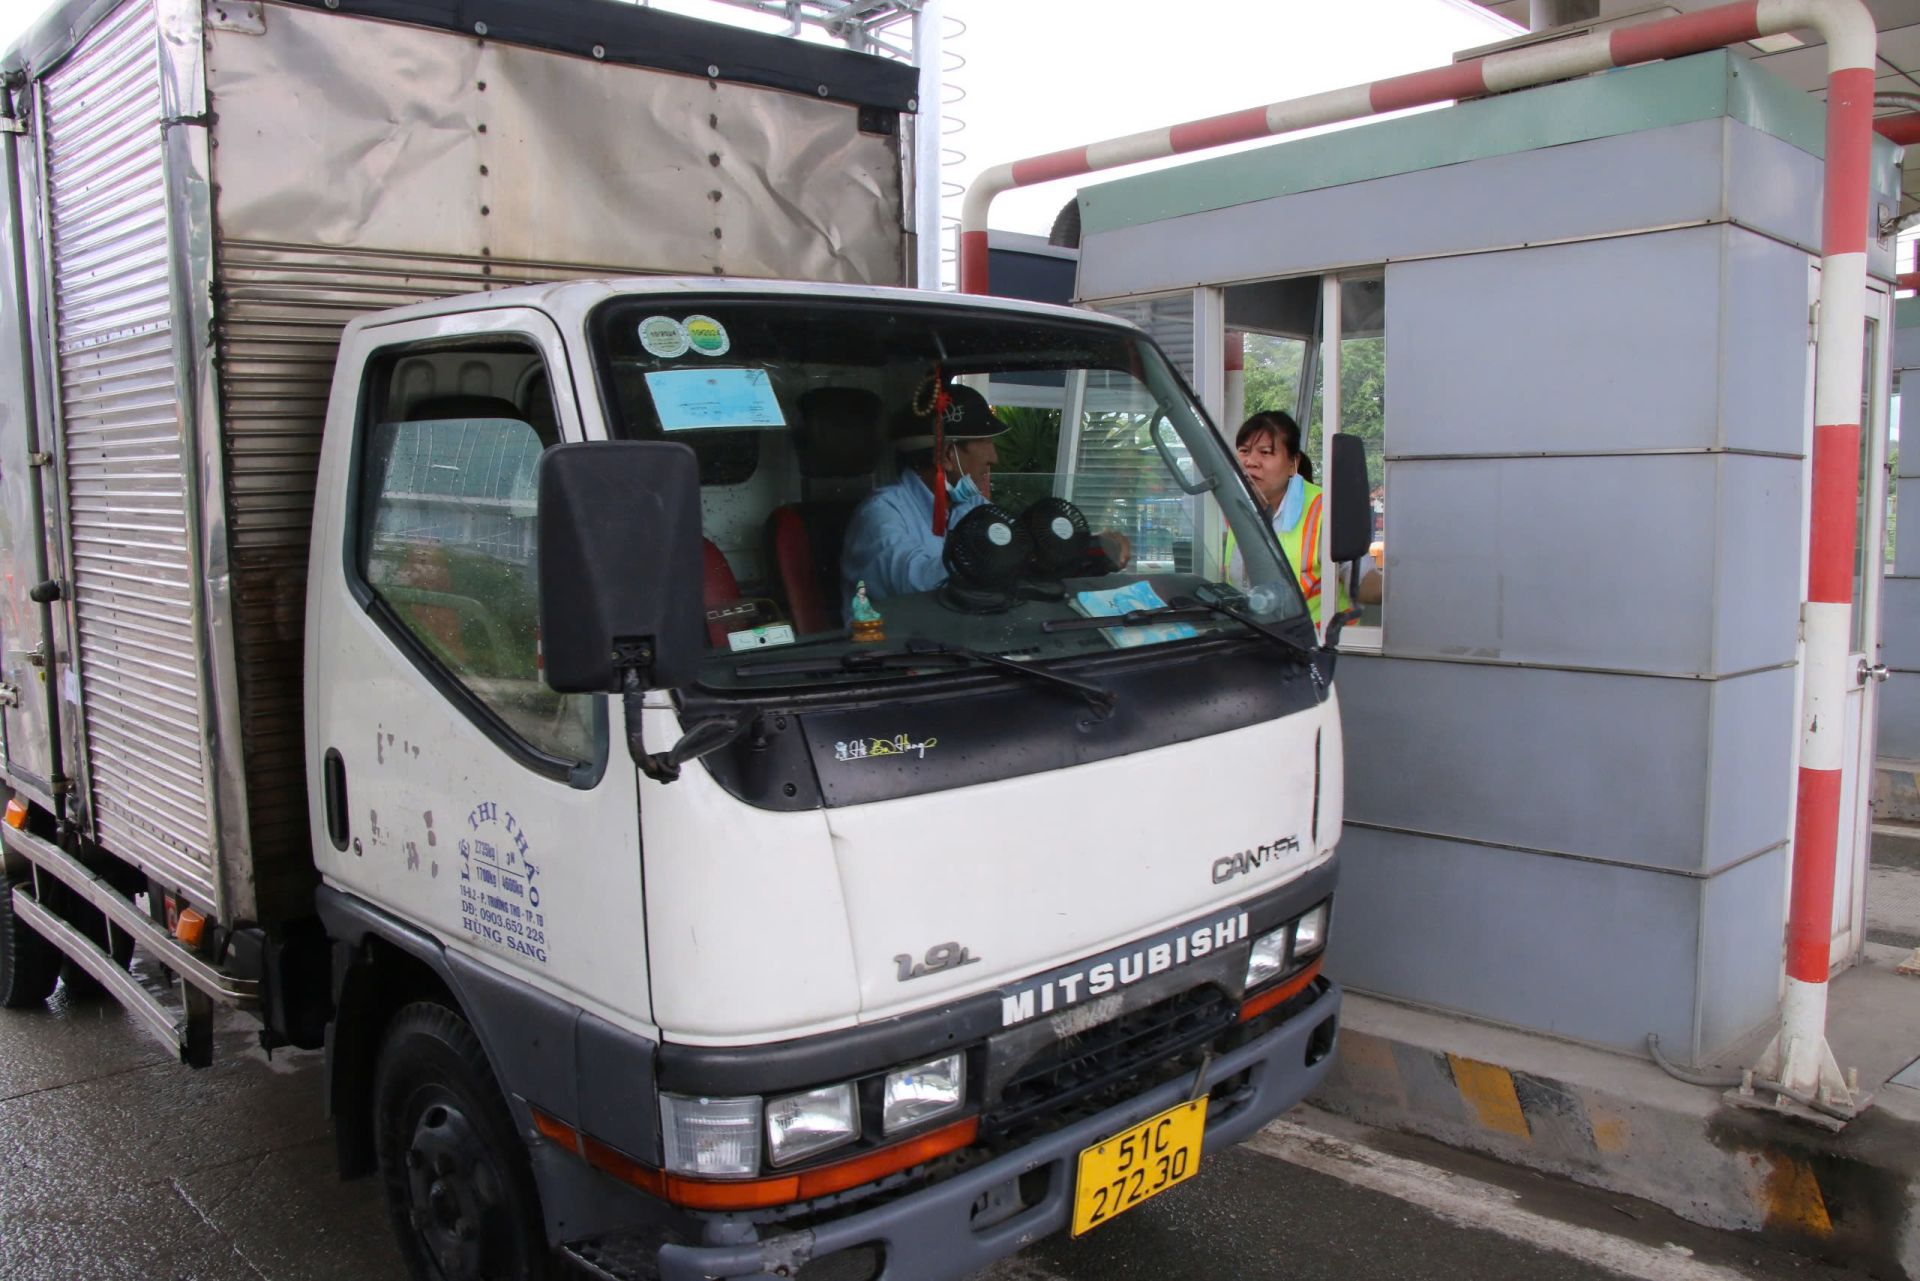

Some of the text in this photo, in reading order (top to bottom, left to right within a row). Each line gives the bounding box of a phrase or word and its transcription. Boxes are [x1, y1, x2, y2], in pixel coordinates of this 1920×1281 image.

[507, 935, 547, 963] SANG
[526, 926, 545, 945] 228
[1002, 912, 1250, 1027] MITSUBISHI
[1118, 1118, 1171, 1172] 51C
[1089, 1146, 1188, 1223] 272.30
